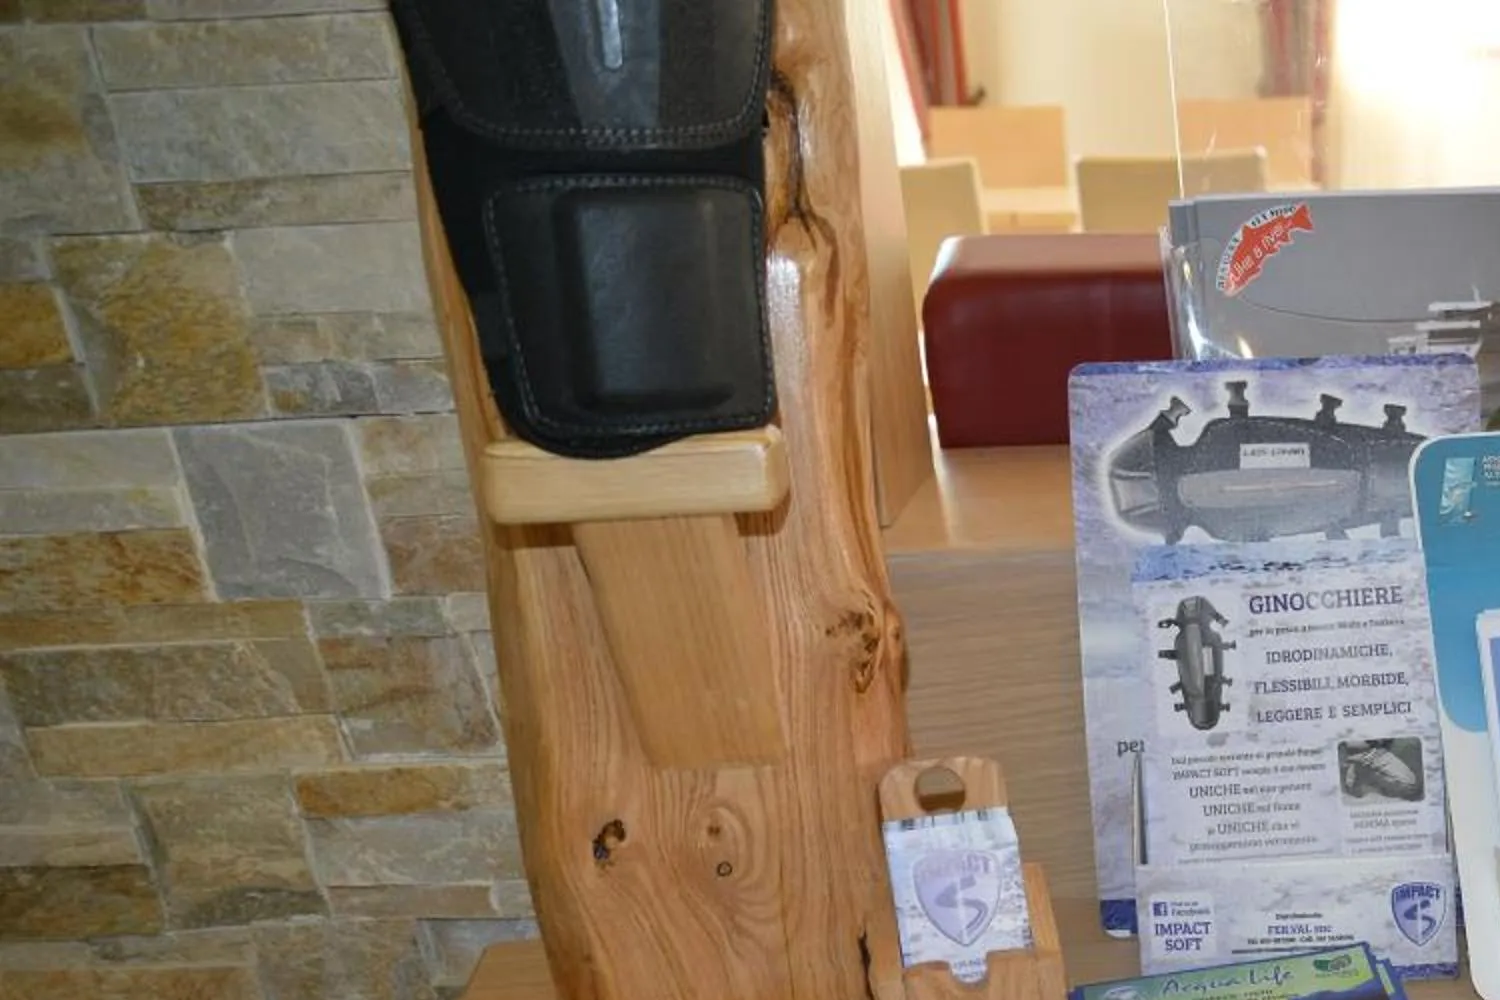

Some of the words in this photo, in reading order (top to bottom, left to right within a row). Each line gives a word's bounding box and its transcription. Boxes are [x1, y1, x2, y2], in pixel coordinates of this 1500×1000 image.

[1249, 585, 1403, 615] GINOCCHIERE
[1265, 643, 1394, 665] IDRODINAMICHE,
[1337, 671, 1409, 688] MORBIDE,
[1257, 707, 1323, 724] LEGGERE
[1342, 701, 1412, 717] SEMPLICI
[1189, 783, 1241, 799] UNICHE
[1203, 802, 1255, 817] UNICHE
[1217, 820, 1269, 835] UNICHE
[1395, 884, 1441, 901] IMPACT
[1154, 922, 1212, 936] IMPACT
[1165, 937, 1203, 951] SOFT
